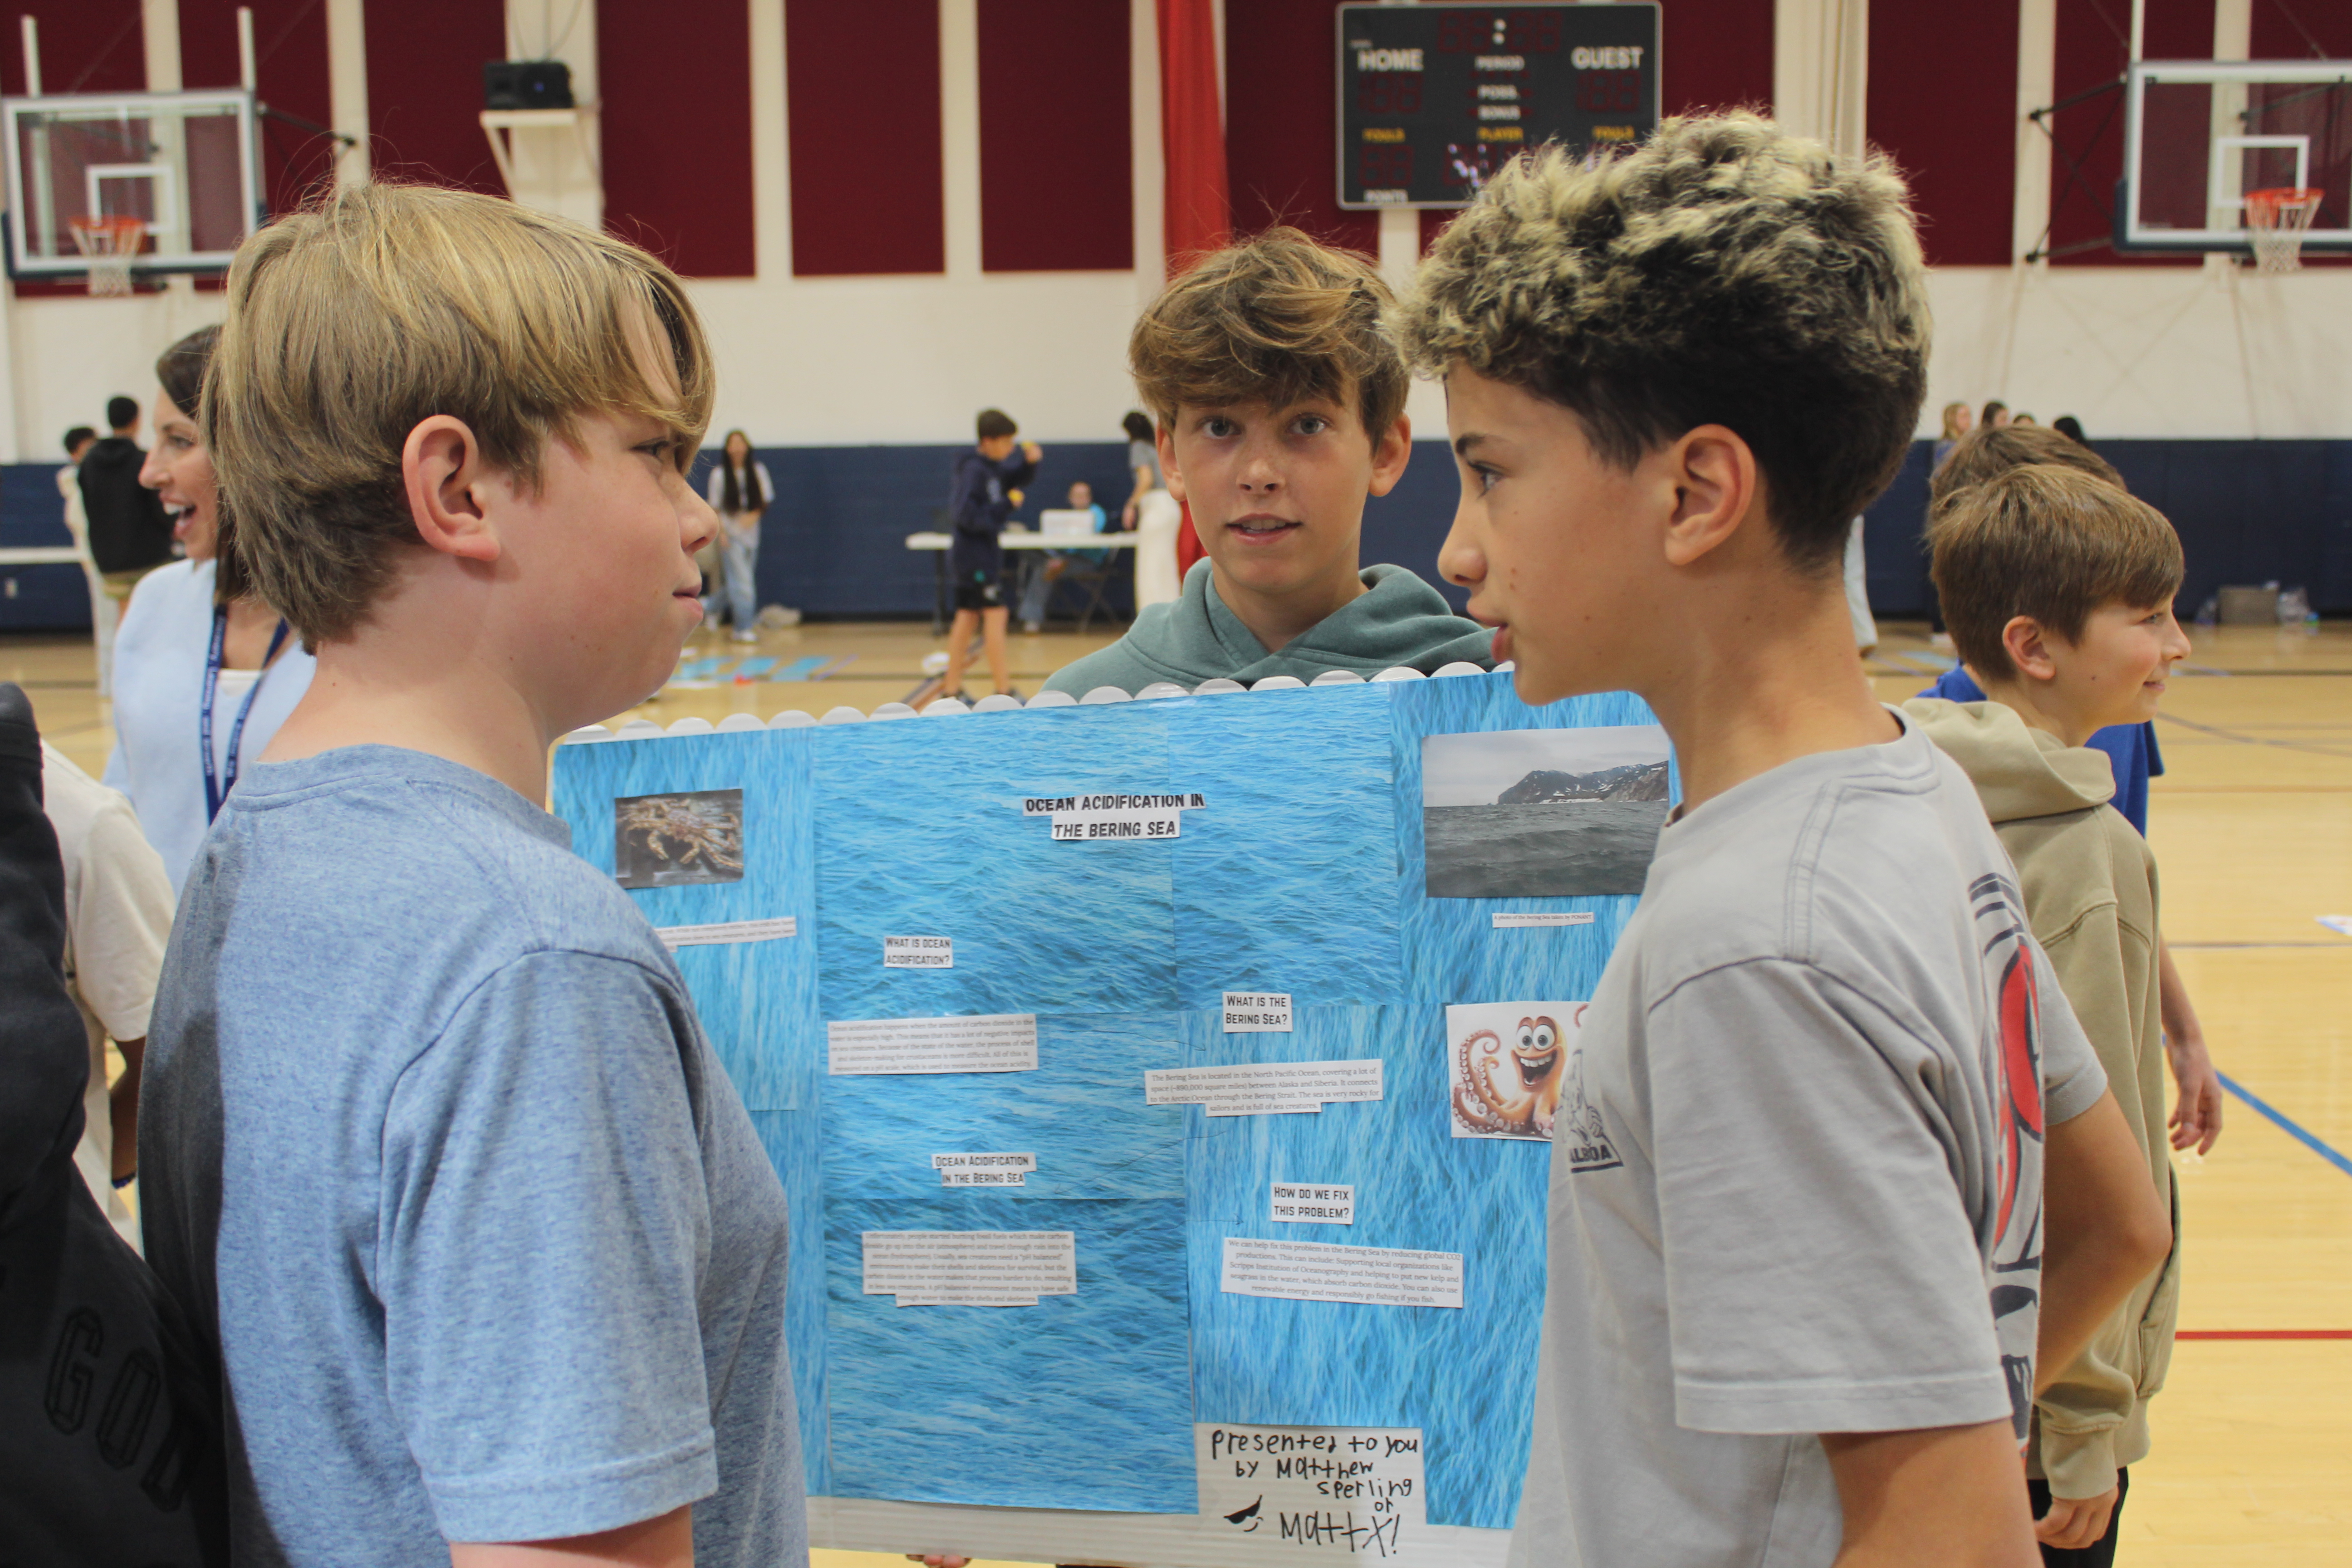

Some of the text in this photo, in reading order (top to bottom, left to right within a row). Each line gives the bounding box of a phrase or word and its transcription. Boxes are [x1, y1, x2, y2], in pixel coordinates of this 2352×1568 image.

[1357, 48, 1424, 71] HOME
[1571, 46, 1643, 69] GUEST
[1026, 794, 1205, 812] OCEAN ACIDIFICATION IN
[1054, 821, 1176, 838] THE BERING SEA
[886, 938, 951, 948] WHAT IS OCEAN
[887, 955, 949, 965] ACIDIFICATION?
[1254, 1241, 1268, 1250] help
[1344, 1246, 1366, 1255] Bering
[1392, 1250, 1422, 1259] reducing
[1336, 1258, 1374, 1267] Supporting
[1230, 1262, 1254, 1271] Scripps
[1256, 1264, 1290, 1272] Institution
[1300, 1267, 1348, 1277] Oceanography
[1365, 1270, 1390, 1280] helping
[1431, 1274, 1445, 1283] kelp
[1325, 1291, 1363, 1299] responsibly
[1376, 1293, 1399, 1302] fishing
[1348, 1436, 1378, 1452] to
[1386, 1436, 1417, 1458] you
[1236, 1457, 1373, 1480] by Matthew
[1375, 1497, 1393, 1513] or
